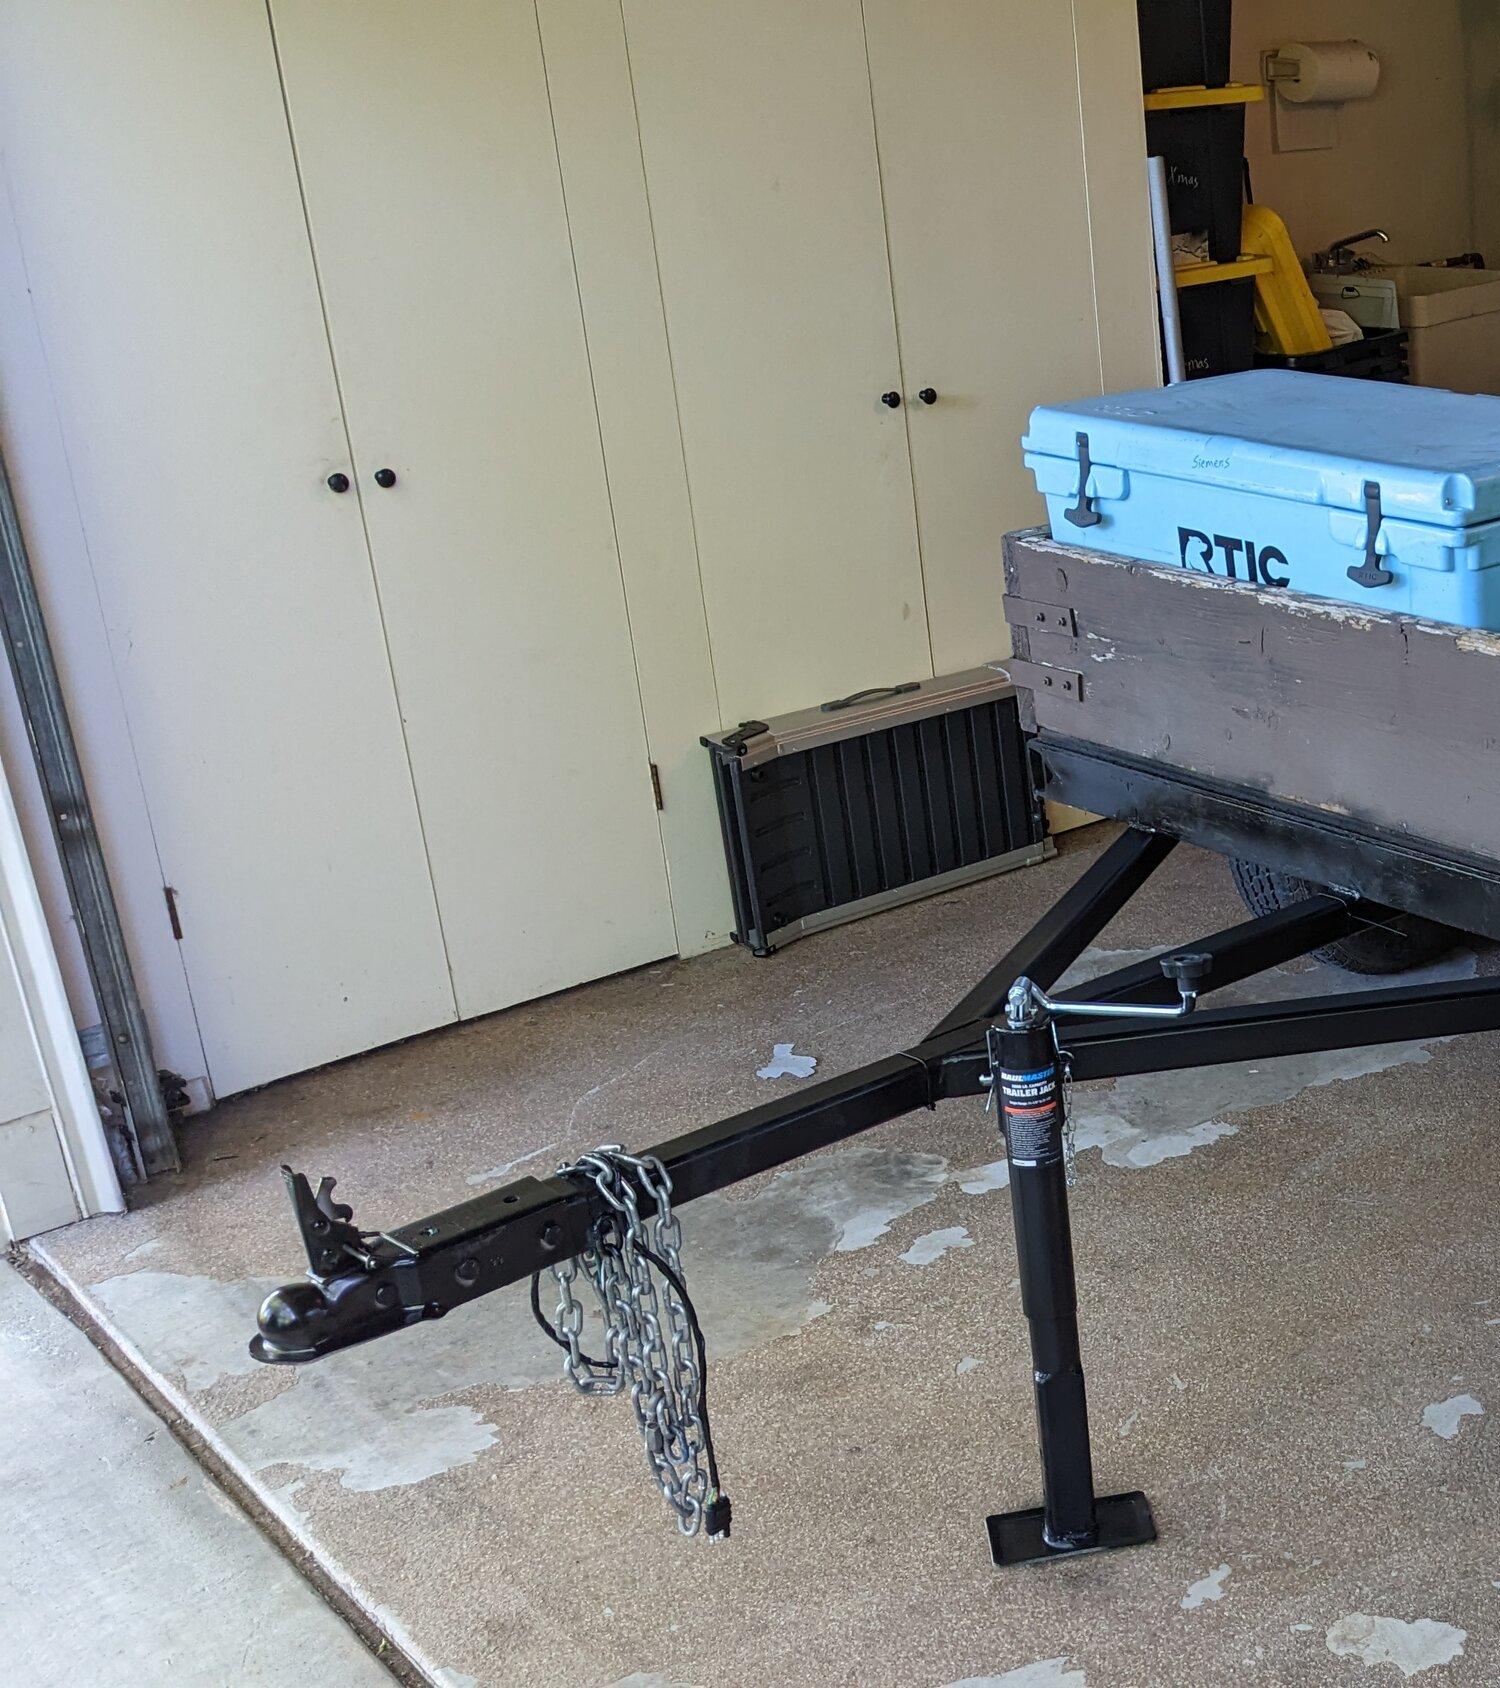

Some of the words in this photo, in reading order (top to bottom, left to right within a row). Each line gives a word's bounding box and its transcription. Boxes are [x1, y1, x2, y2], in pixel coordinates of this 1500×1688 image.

[1184, 358, 1210, 372] mas
[1191, 454, 1231, 470] Siemens
[1177, 526, 1291, 588] RTIC
[1002, 1085, 1039, 1098] TRAILER
